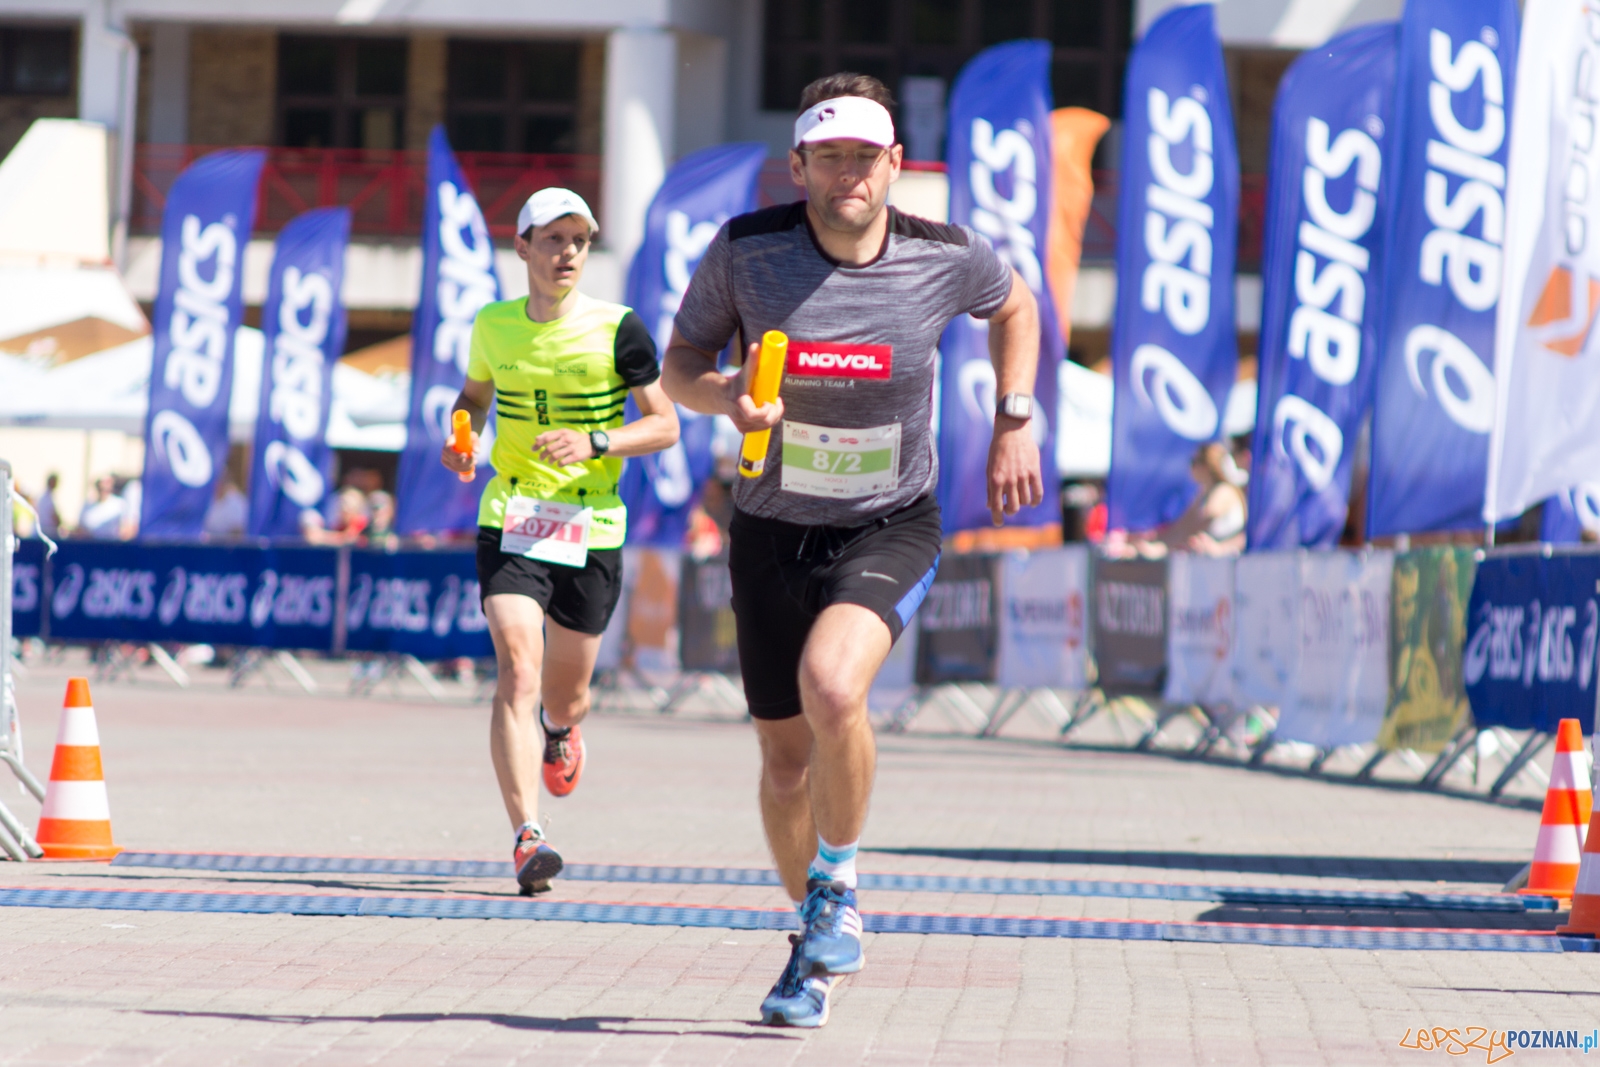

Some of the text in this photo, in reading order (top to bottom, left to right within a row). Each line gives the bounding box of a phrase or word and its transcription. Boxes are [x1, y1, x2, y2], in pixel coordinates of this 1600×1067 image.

[1141, 86, 1214, 335] asics
[1287, 116, 1383, 386] asics
[1418, 27, 1505, 312] asics
[164, 213, 237, 408] asics
[270, 265, 333, 440] asics
[784, 377, 846, 389] RUNNING TEAM
[797, 352, 884, 371] NOVOL
[512, 514, 573, 543] 207/1
[812, 450, 863, 474] 8/2
